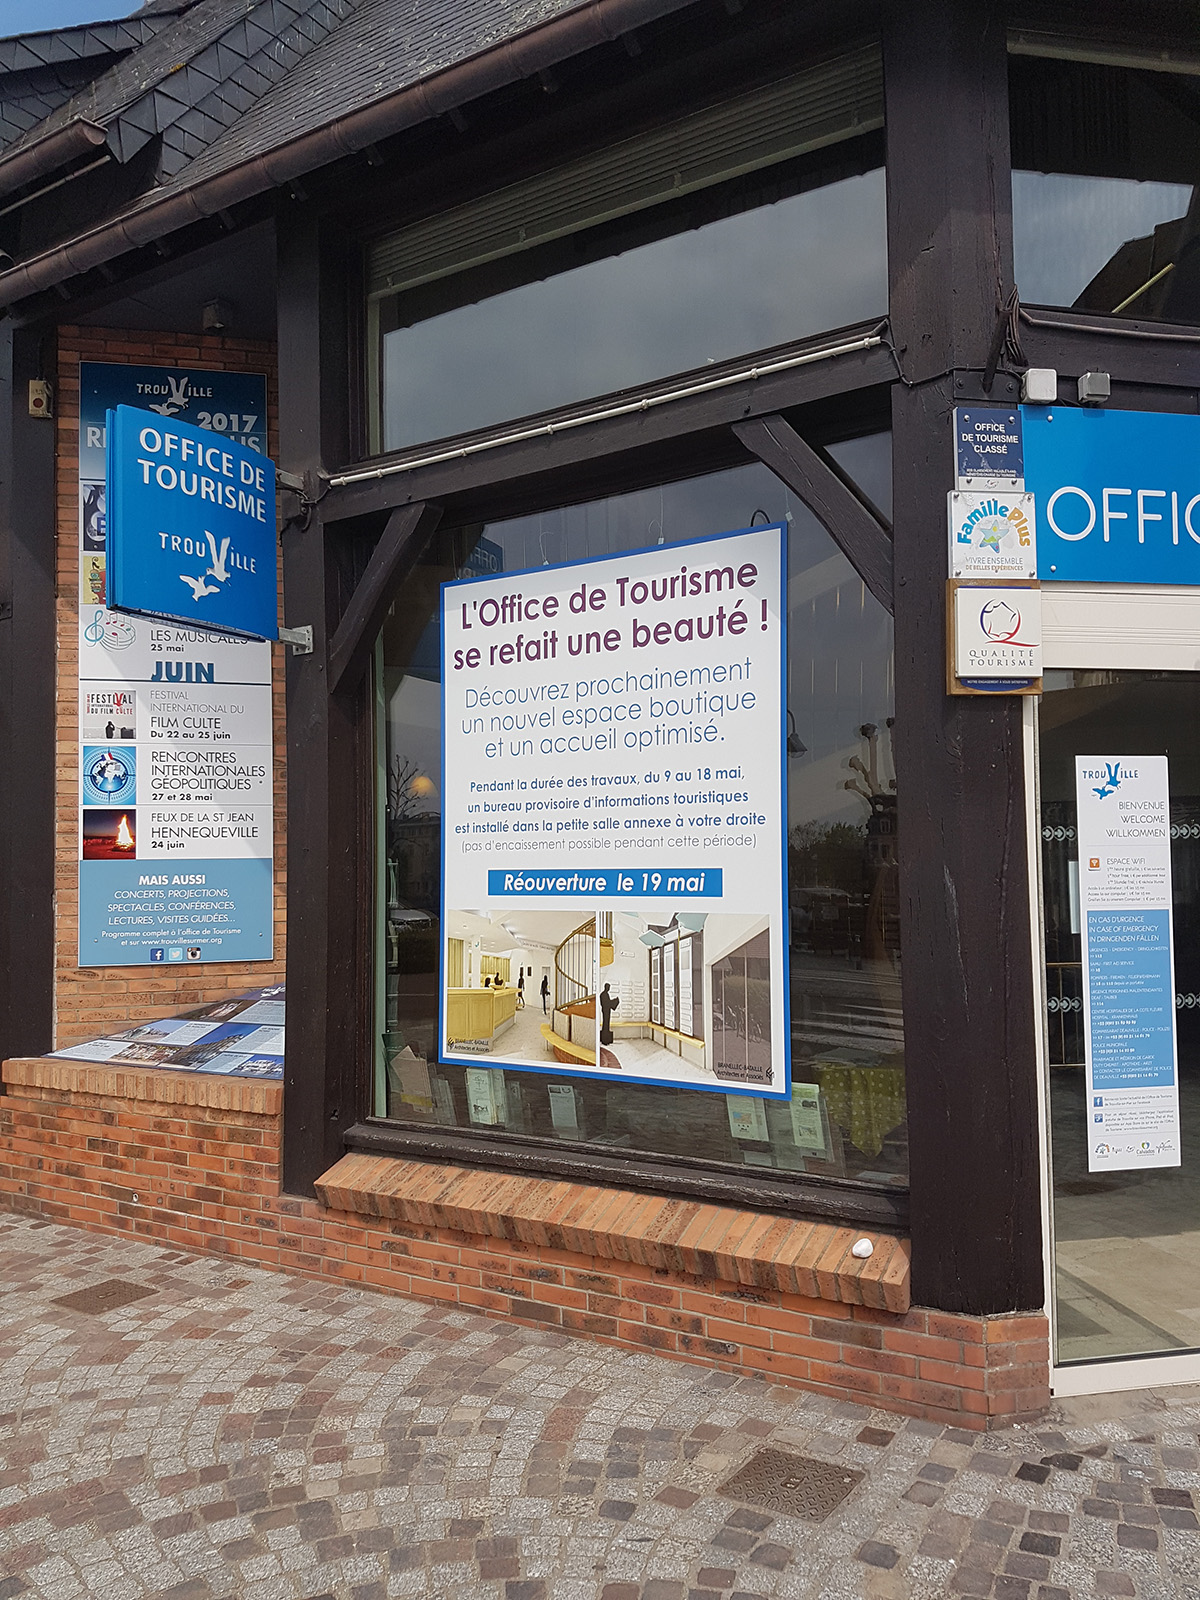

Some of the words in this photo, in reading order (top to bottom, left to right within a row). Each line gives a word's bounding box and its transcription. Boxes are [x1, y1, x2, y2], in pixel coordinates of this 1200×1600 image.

[197, 412, 259, 432] 2017
[975, 423, 1005, 432] OFFICE
[962, 434, 974, 442] DE
[975, 434, 1018, 443] TOURISME
[974, 444, 1007, 454] CLASSÉ
[138, 428, 234, 478] OFFICE
[240, 460, 265, 492] DE
[137, 458, 266, 523] TOURISME
[958, 500, 1009, 545] Famille
[1008, 507, 1030, 547] Plus
[462, 594, 559, 629] L'Office
[569, 584, 606, 614] de
[616, 562, 758, 607] Tourisme
[150, 630, 170, 642] LES
[454, 648, 481, 670] se
[490, 630, 558, 666] refait
[568, 629, 621, 656] une
[632, 599, 748, 648] beauté
[760, 598, 768, 631] !
[969, 649, 1033, 658] QUALITÉ
[151, 661, 214, 682] JUIN
[465, 682, 569, 709] Découvrez
[576, 657, 752, 702] prochainement
[91, 693, 132, 706] FESTIVAL
[150, 691, 188, 699] FESTIVAL
[150, 703, 227, 713] INTERNATIONAL
[230, 704, 244, 714] DU
[462, 716, 484, 734] un
[490, 707, 556, 731] nouvel
[562, 703, 641, 728] espace
[650, 691, 756, 718] boutique
[151, 717, 178, 728] FILM
[183, 718, 221, 729] CULTE
[213, 732, 230, 740] juin
[485, 738, 504, 758] et
[510, 740, 533, 756] un
[540, 728, 616, 752] accueil
[624, 718, 725, 752] optimisé.
[152, 752, 236, 763] RENCONTRES
[152, 765, 265, 776] INTERNATIONALES
[151, 774, 251, 790] GÉOPOLITIQUES
[470, 780, 514, 793] Pendant
[517, 779, 527, 790] la
[530, 776, 564, 790] durée
[567, 776, 587, 788] des
[591, 774, 640, 786] travaux,
[644, 772, 660, 784] du
[664, 770, 671, 782] 9
[675, 771, 691, 781] au
[697, 768, 711, 780] 18
[716, 766, 745, 780] mai,
[468, 803, 480, 813] un
[484, 802, 522, 812] bureau
[526, 798, 580, 813] provisoire
[583, 794, 669, 808] d'informations
[674, 791, 749, 805] touristiques
[152, 813, 177, 822] FEUX
[181, 813, 193, 822] DE
[198, 813, 210, 822] LA
[213, 813, 225, 822] ST
[227, 813, 254, 822] JEAN
[455, 823, 470, 834] est
[472, 820, 509, 833] installé
[513, 820, 539, 832] dans
[542, 820, 552, 831] la
[556, 818, 589, 833] petite
[593, 818, 620, 830] salle
[624, 818, 671, 829] annexe
[676, 814, 684, 827] à
[688, 814, 721, 826] votre
[726, 813, 766, 826] droite
[1121, 815, 1165, 824] WELCOME
[152, 827, 258, 839] HENNEQUEVILLE
[1106, 829, 1166, 838] WILLKOMMEN
[167, 841, 185, 850] juin
[462, 840, 482, 853] (pas
[485, 838, 565, 851] d'encaissement
[569, 838, 611, 851] possible
[614, 836, 664, 850] pendant
[667, 836, 699, 847] cette
[703, 834, 757, 849] période)
[139, 875, 168, 885] MAIS
[172, 875, 206, 885] AUSSI
[504, 872, 607, 891] Réouverture
[617, 873, 634, 891] le
[642, 873, 661, 891] 19
[667, 872, 705, 891] mai
[114, 890, 166, 900] CONCERTS,
[168, 889, 230, 899] PROJECTIONS,
[108, 903, 166, 912] SPECTACLES,
[168, 900, 236, 911] CONFÉRENCES,
[108, 915, 155, 925] LECTURES,
[158, 915, 188, 924] VISITES
[102, 931, 140, 939] Programme
[142, 929, 170, 939] complet
